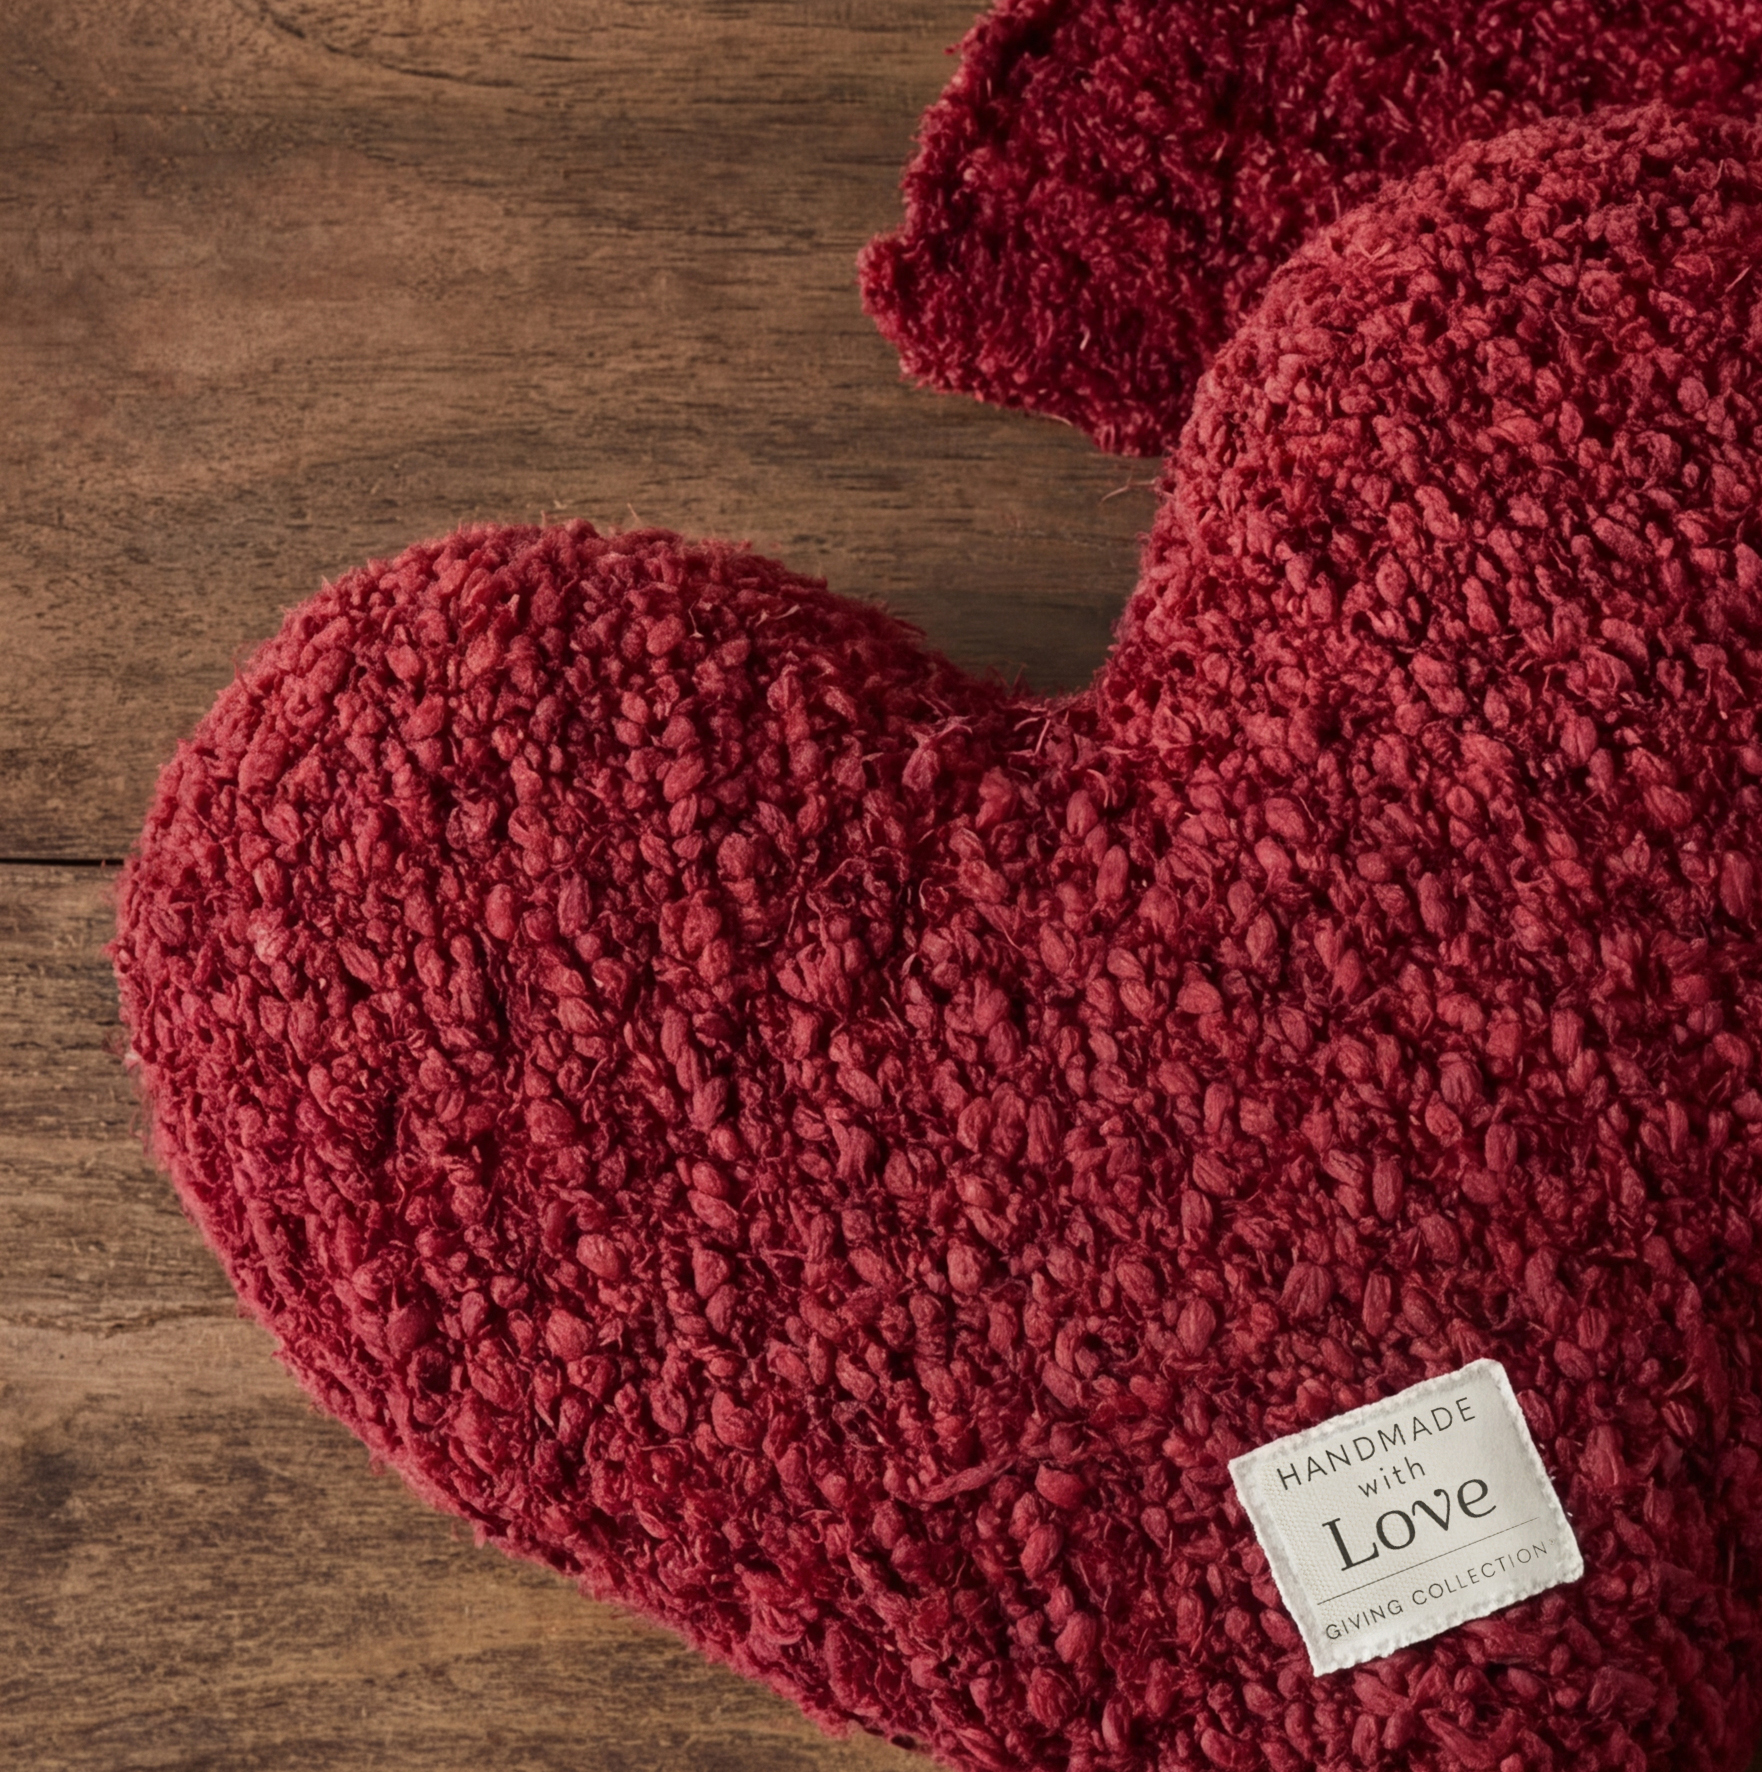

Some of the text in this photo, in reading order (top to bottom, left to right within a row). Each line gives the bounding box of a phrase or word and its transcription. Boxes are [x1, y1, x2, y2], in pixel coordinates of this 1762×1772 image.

[1276, 1396, 1476, 1490] HANDMADE
[1357, 1456, 1426, 1498] with
[1321, 1478, 1497, 1571] Love
[1325, 1541, 1548, 1640] GIVING COLLECTION
